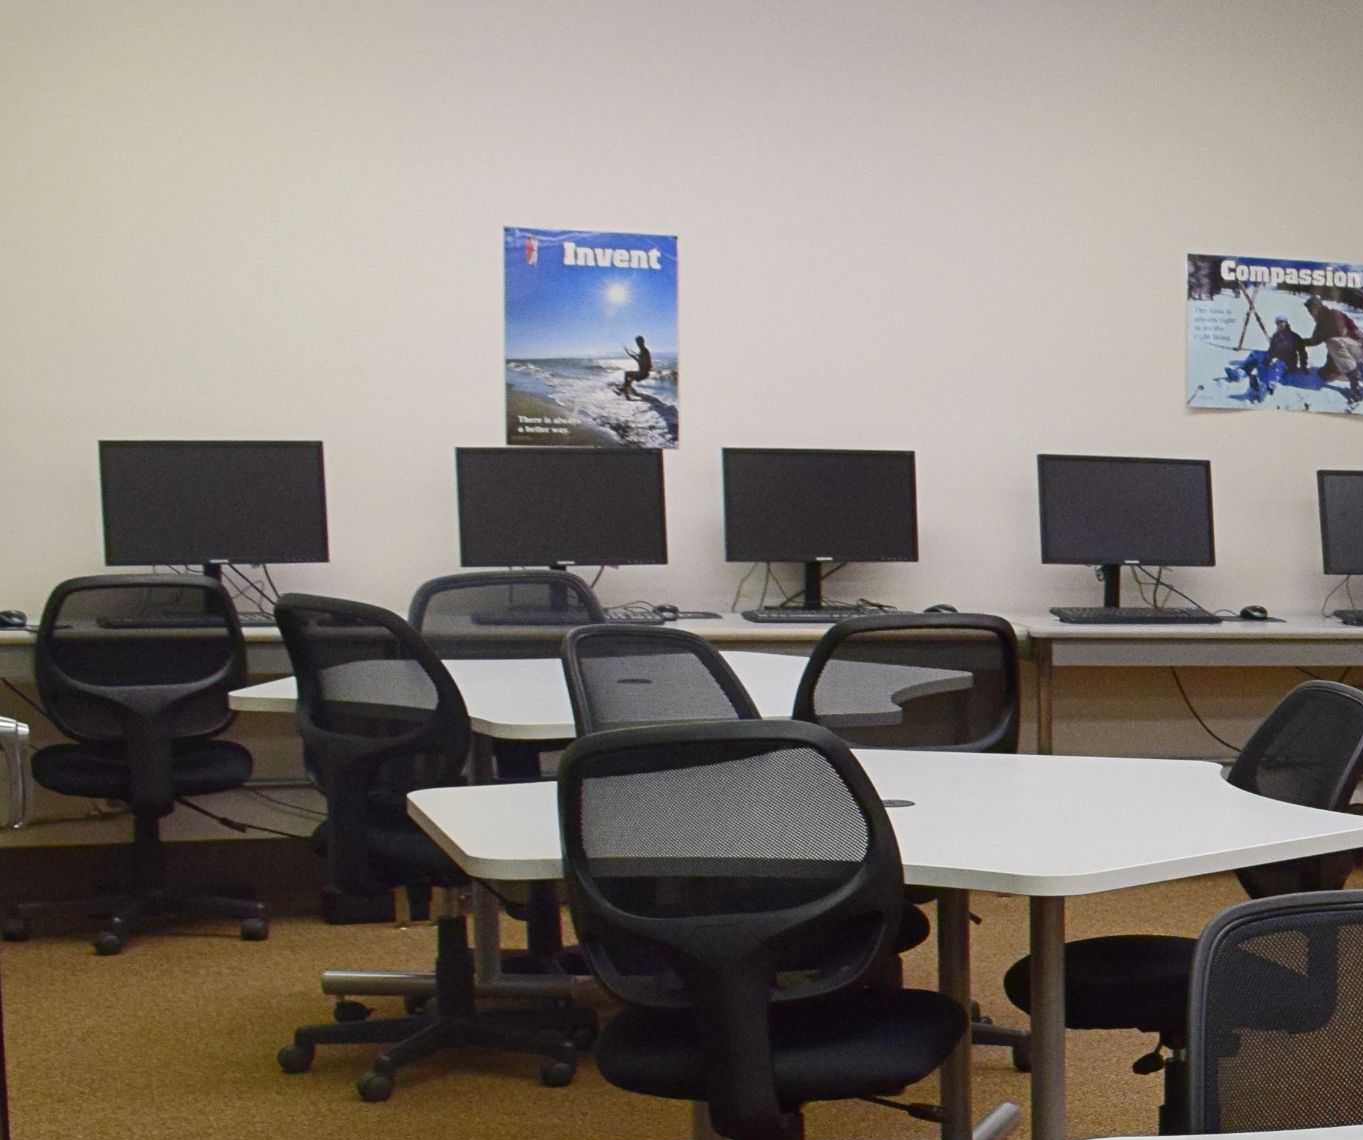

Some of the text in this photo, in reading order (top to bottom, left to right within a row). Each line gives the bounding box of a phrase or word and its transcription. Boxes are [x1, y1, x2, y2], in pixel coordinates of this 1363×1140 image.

[563, 241, 661, 270] Invent
[1221, 259, 1361, 288] Compassion
[517, 415, 543, 423] There
[543, 416, 552, 424] is
